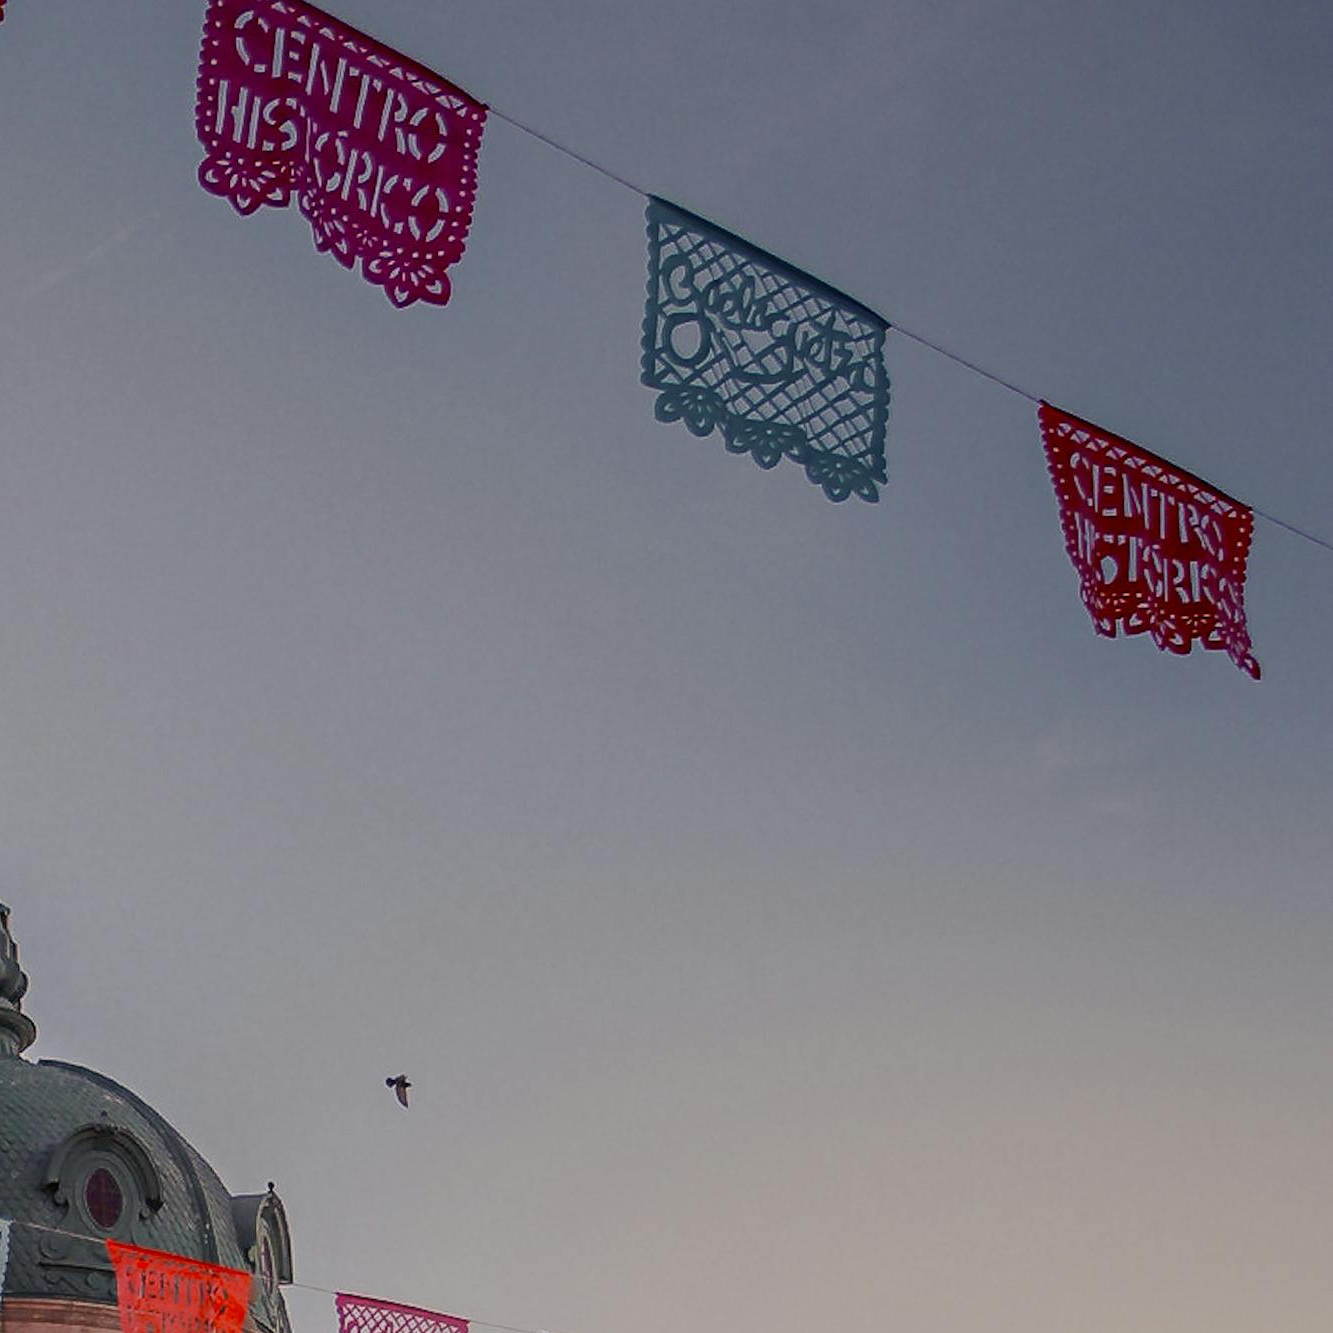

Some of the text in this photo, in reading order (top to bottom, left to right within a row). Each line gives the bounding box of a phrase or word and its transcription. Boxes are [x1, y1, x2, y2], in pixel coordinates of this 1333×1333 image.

[217, 79, 449, 240] HISÓRICO
[235, 10, 449, 163] CENTRO
[1069, 452, 1226, 561] CENTRO
